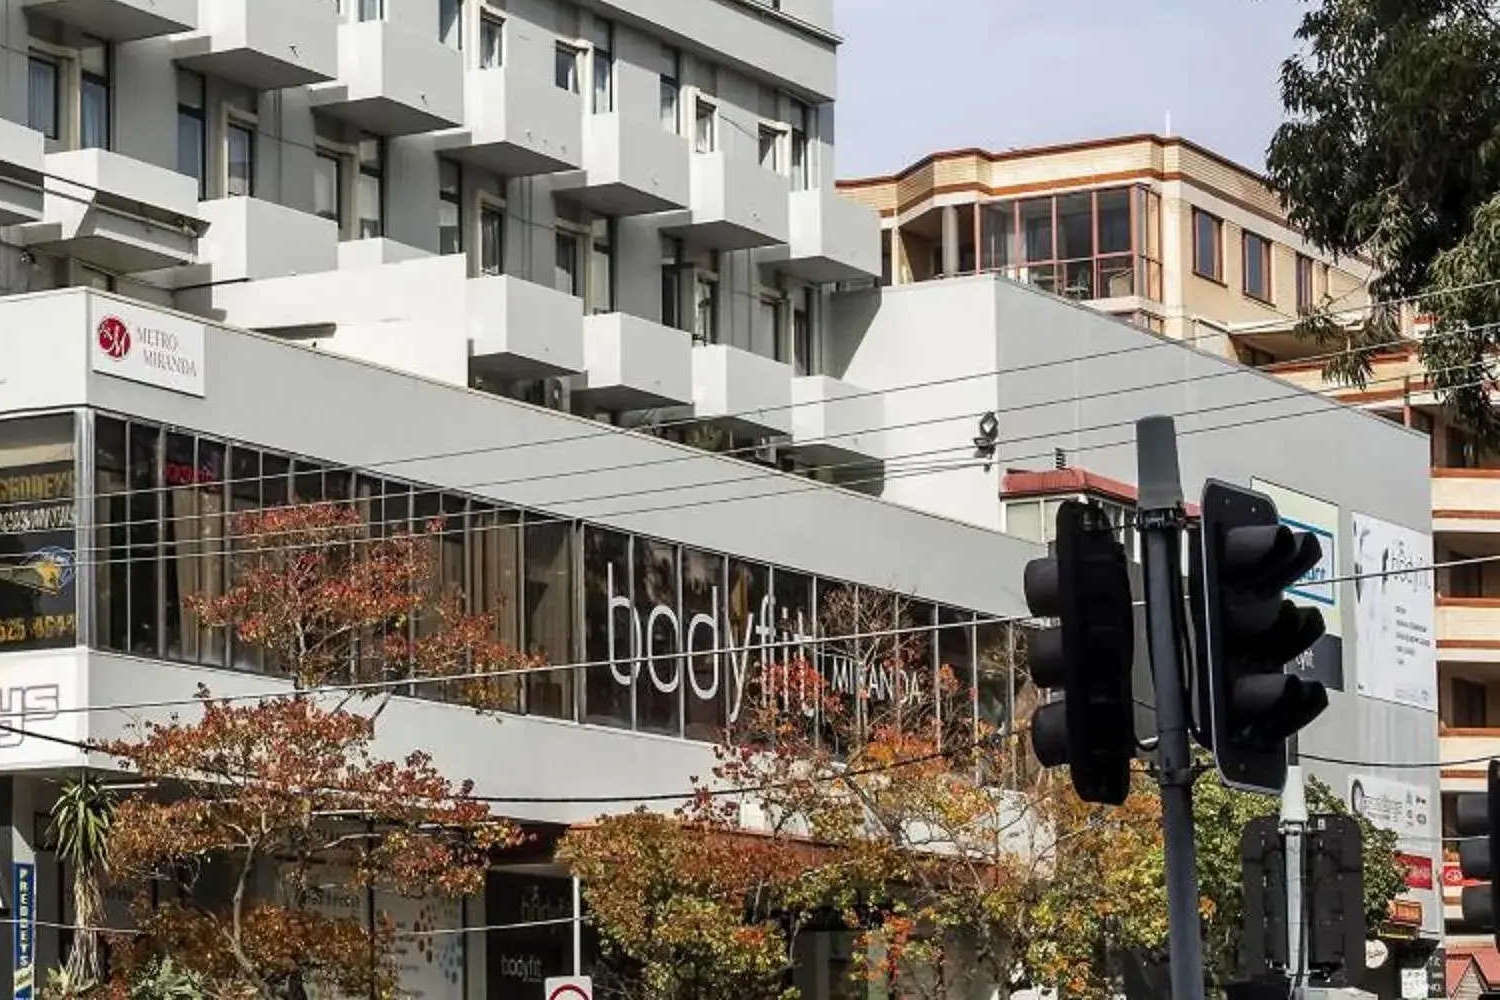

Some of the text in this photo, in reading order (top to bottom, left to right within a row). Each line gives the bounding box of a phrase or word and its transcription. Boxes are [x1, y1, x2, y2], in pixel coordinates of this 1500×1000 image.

[137, 326, 179, 353] METRO
[143, 347, 198, 378] MIRANDA
[606, 561, 814, 723] bodyfit
[832, 654, 923, 705] MIANDA
[19, 867, 29, 967] PREDDEYS
